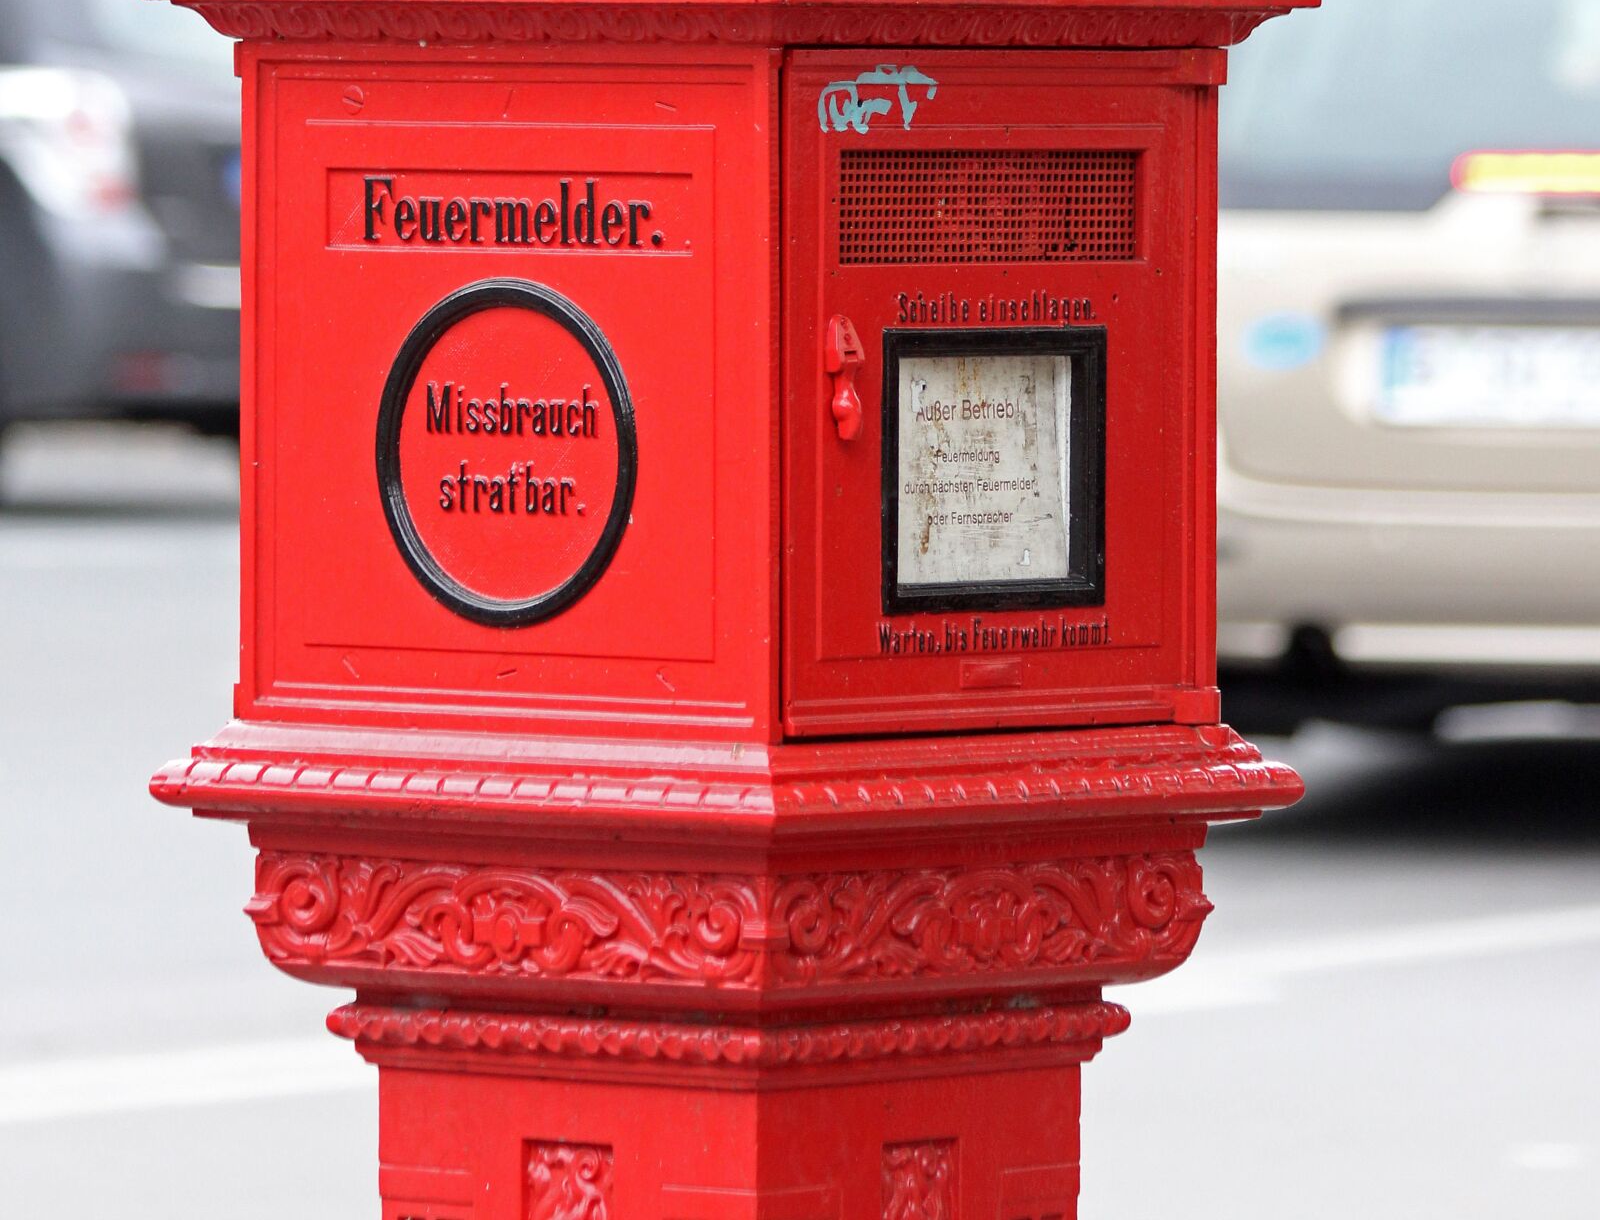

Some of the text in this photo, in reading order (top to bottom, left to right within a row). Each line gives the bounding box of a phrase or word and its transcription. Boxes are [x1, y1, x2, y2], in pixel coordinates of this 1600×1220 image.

[362, 174, 664, 246] Feuermelder.
[898, 290, 969, 324] Scheibe
[426, 380, 600, 439] Missbrauch
[915, 398, 1021, 422] Außer Betrieb!
[934, 449, 1001, 464] Feuermeldung
[439, 459, 587, 516] strafbar.
[904, 477, 1036, 495] durch nächsten Feuermelder
[927, 510, 1014, 527] oder Fernsprecher
[878, 614, 1112, 654] Warten, bis Feuerwehr kommt.
